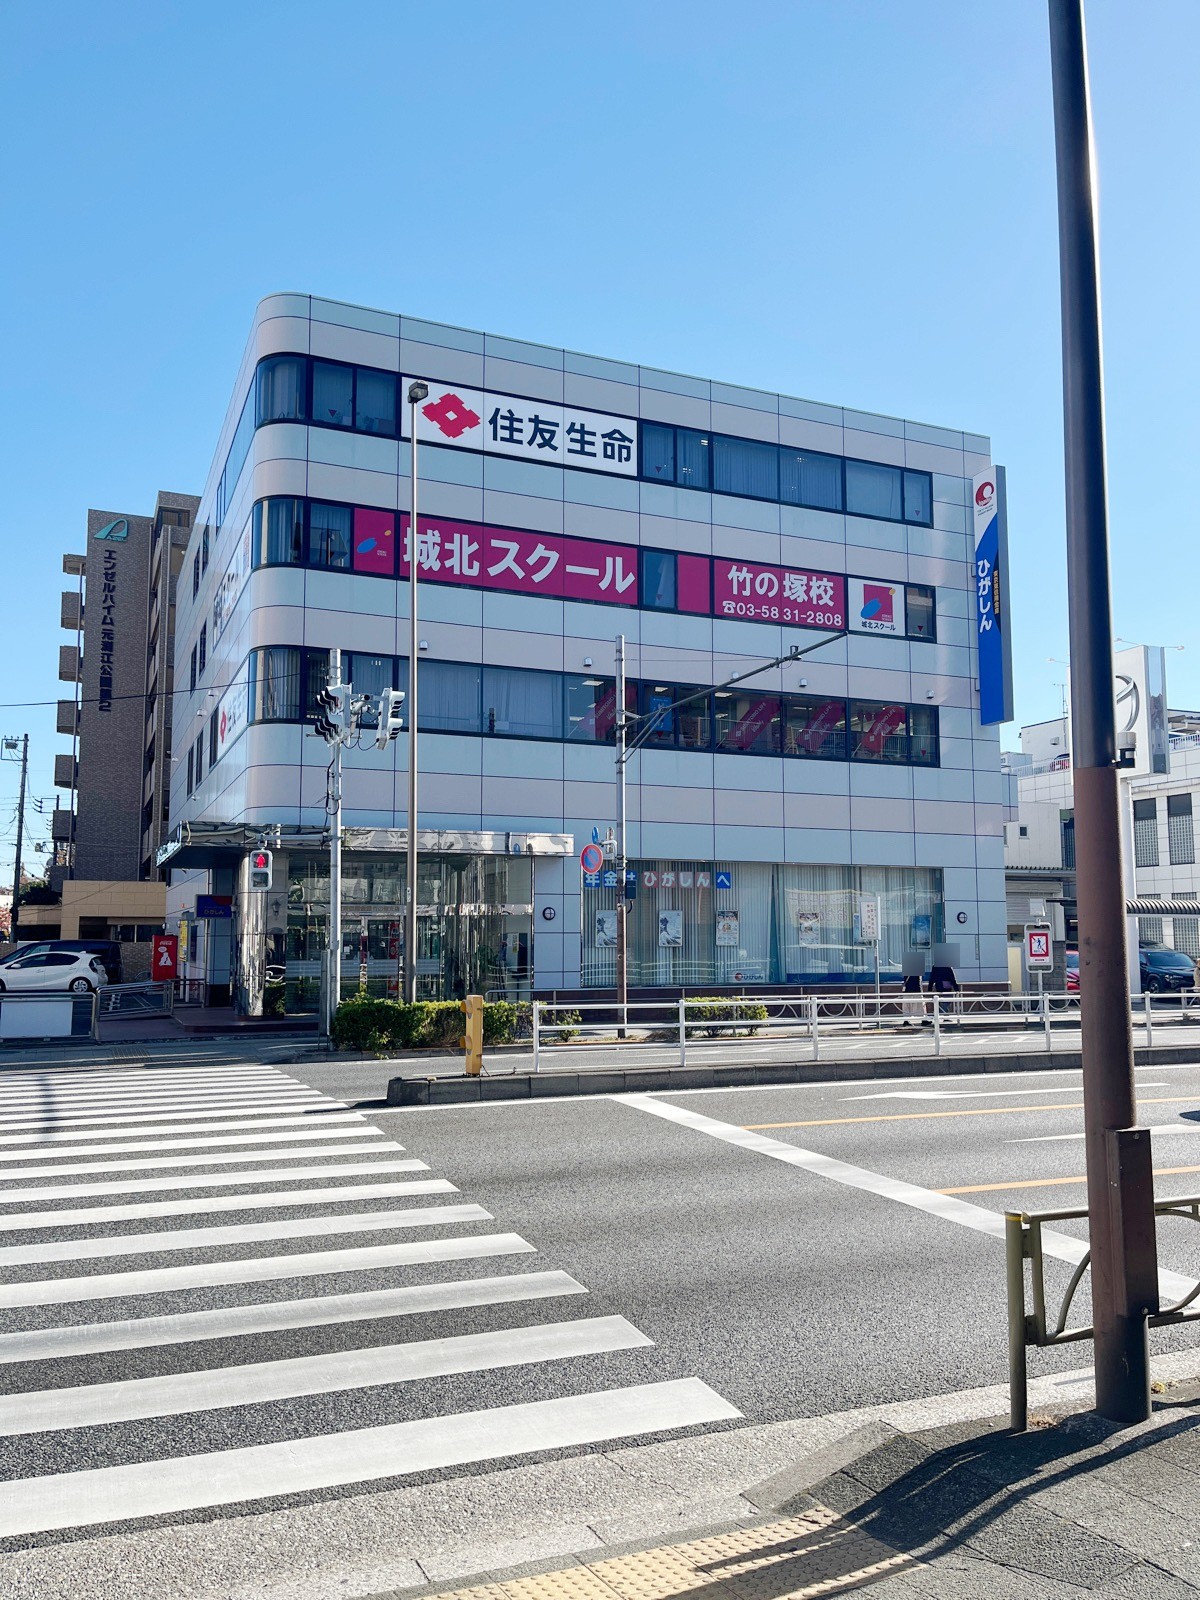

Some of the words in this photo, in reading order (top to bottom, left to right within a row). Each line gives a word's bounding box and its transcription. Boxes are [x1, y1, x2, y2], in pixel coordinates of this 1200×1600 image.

[488, 407, 634, 463] 住友生命
[403, 527, 636, 593] 城北スクール
[727, 564, 835, 607] 竹の塚校
[976, 558, 993, 634] ひがしん
[736, 601, 843, 627] 03-5831-2808
[861, 620, 897, 632] 城北スクール
